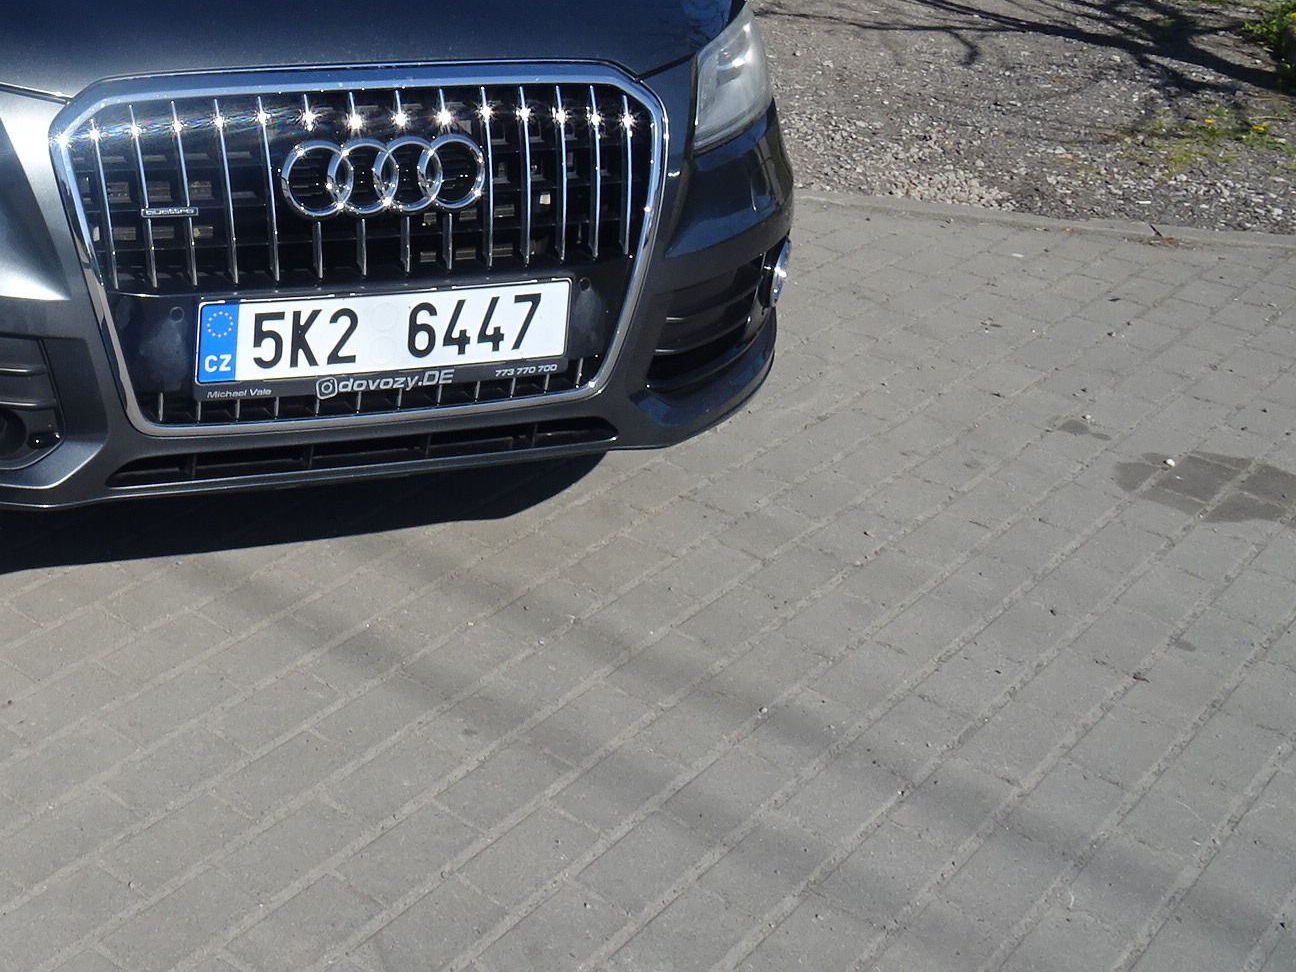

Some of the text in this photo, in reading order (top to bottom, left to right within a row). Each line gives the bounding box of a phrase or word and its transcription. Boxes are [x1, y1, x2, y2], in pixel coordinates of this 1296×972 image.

[251, 292, 543, 369] 5K2 6447
[203, 353, 233, 373] CZ
[495, 363, 559, 377] 773 770 700
[337, 368, 455, 391] dovozy.DE
[206, 388, 248, 399] Michael
